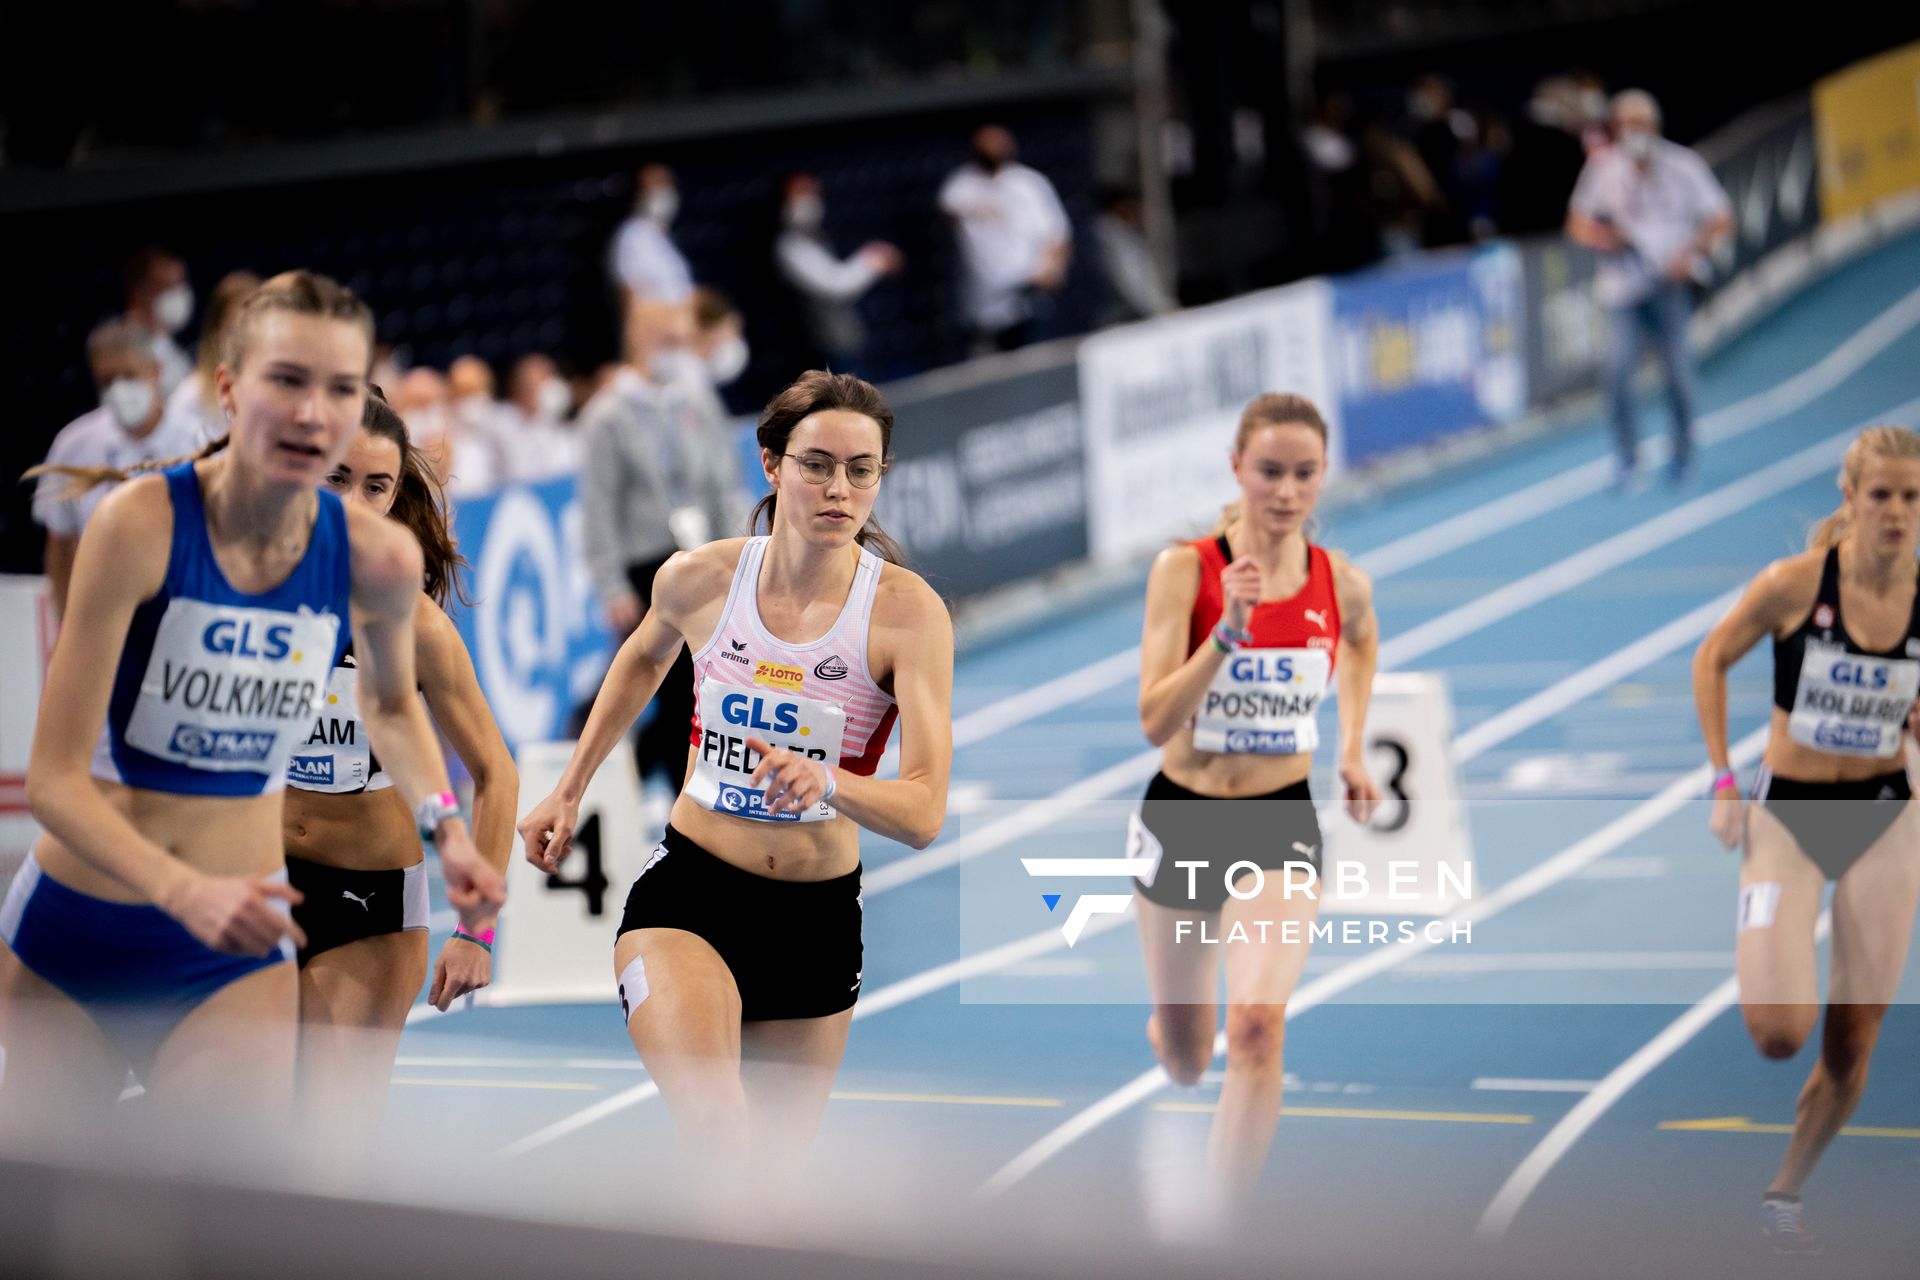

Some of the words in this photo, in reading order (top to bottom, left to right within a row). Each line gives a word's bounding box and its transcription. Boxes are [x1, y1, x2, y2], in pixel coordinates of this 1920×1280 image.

[720, 651, 750, 666] erima
[770, 667, 804, 682] LOTTO
[162, 660, 316, 719] VOLKMER
[1206, 691, 1318, 718] POSNIAK
[289, 758, 331, 775] PLAN
[1370, 737, 1411, 834] 3
[547, 813, 608, 916] 4
